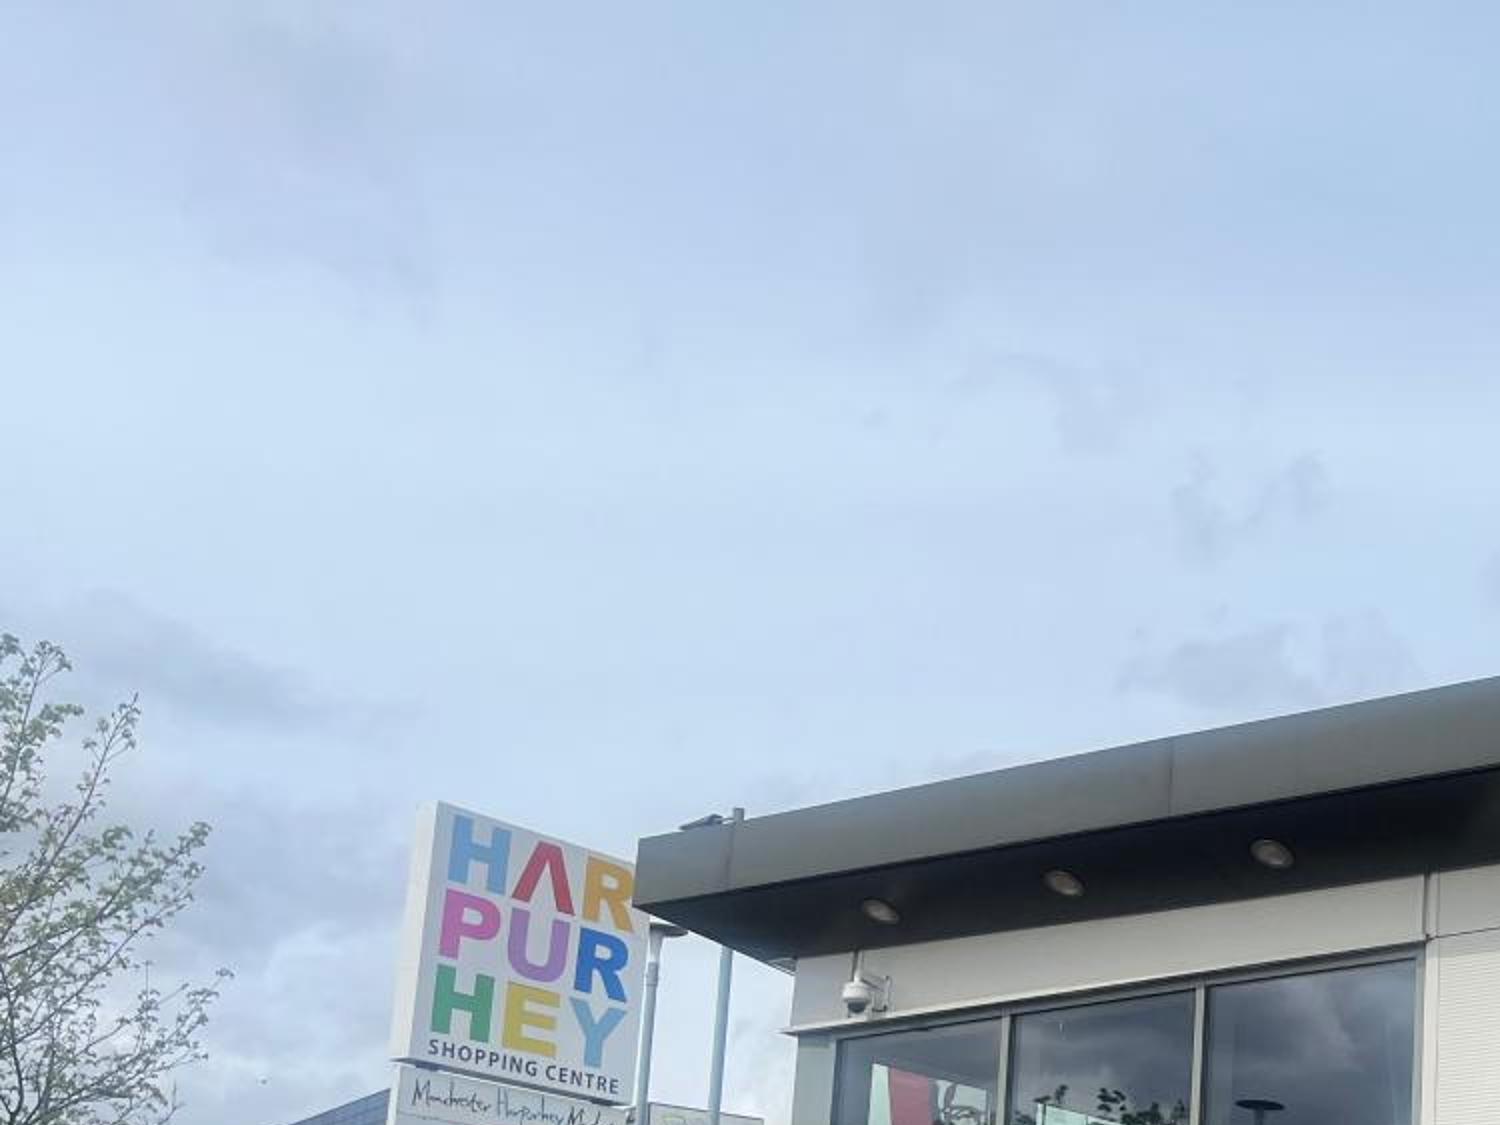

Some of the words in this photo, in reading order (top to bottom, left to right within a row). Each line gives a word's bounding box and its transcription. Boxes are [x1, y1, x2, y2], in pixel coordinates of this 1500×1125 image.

[447, 813, 634, 933] HAR
[438, 887, 630, 1003] PUR
[427, 1038, 538, 1078] SHOPPING
[545, 1064, 620, 1095] CENTRE
[430, 963, 628, 1069] HEY
